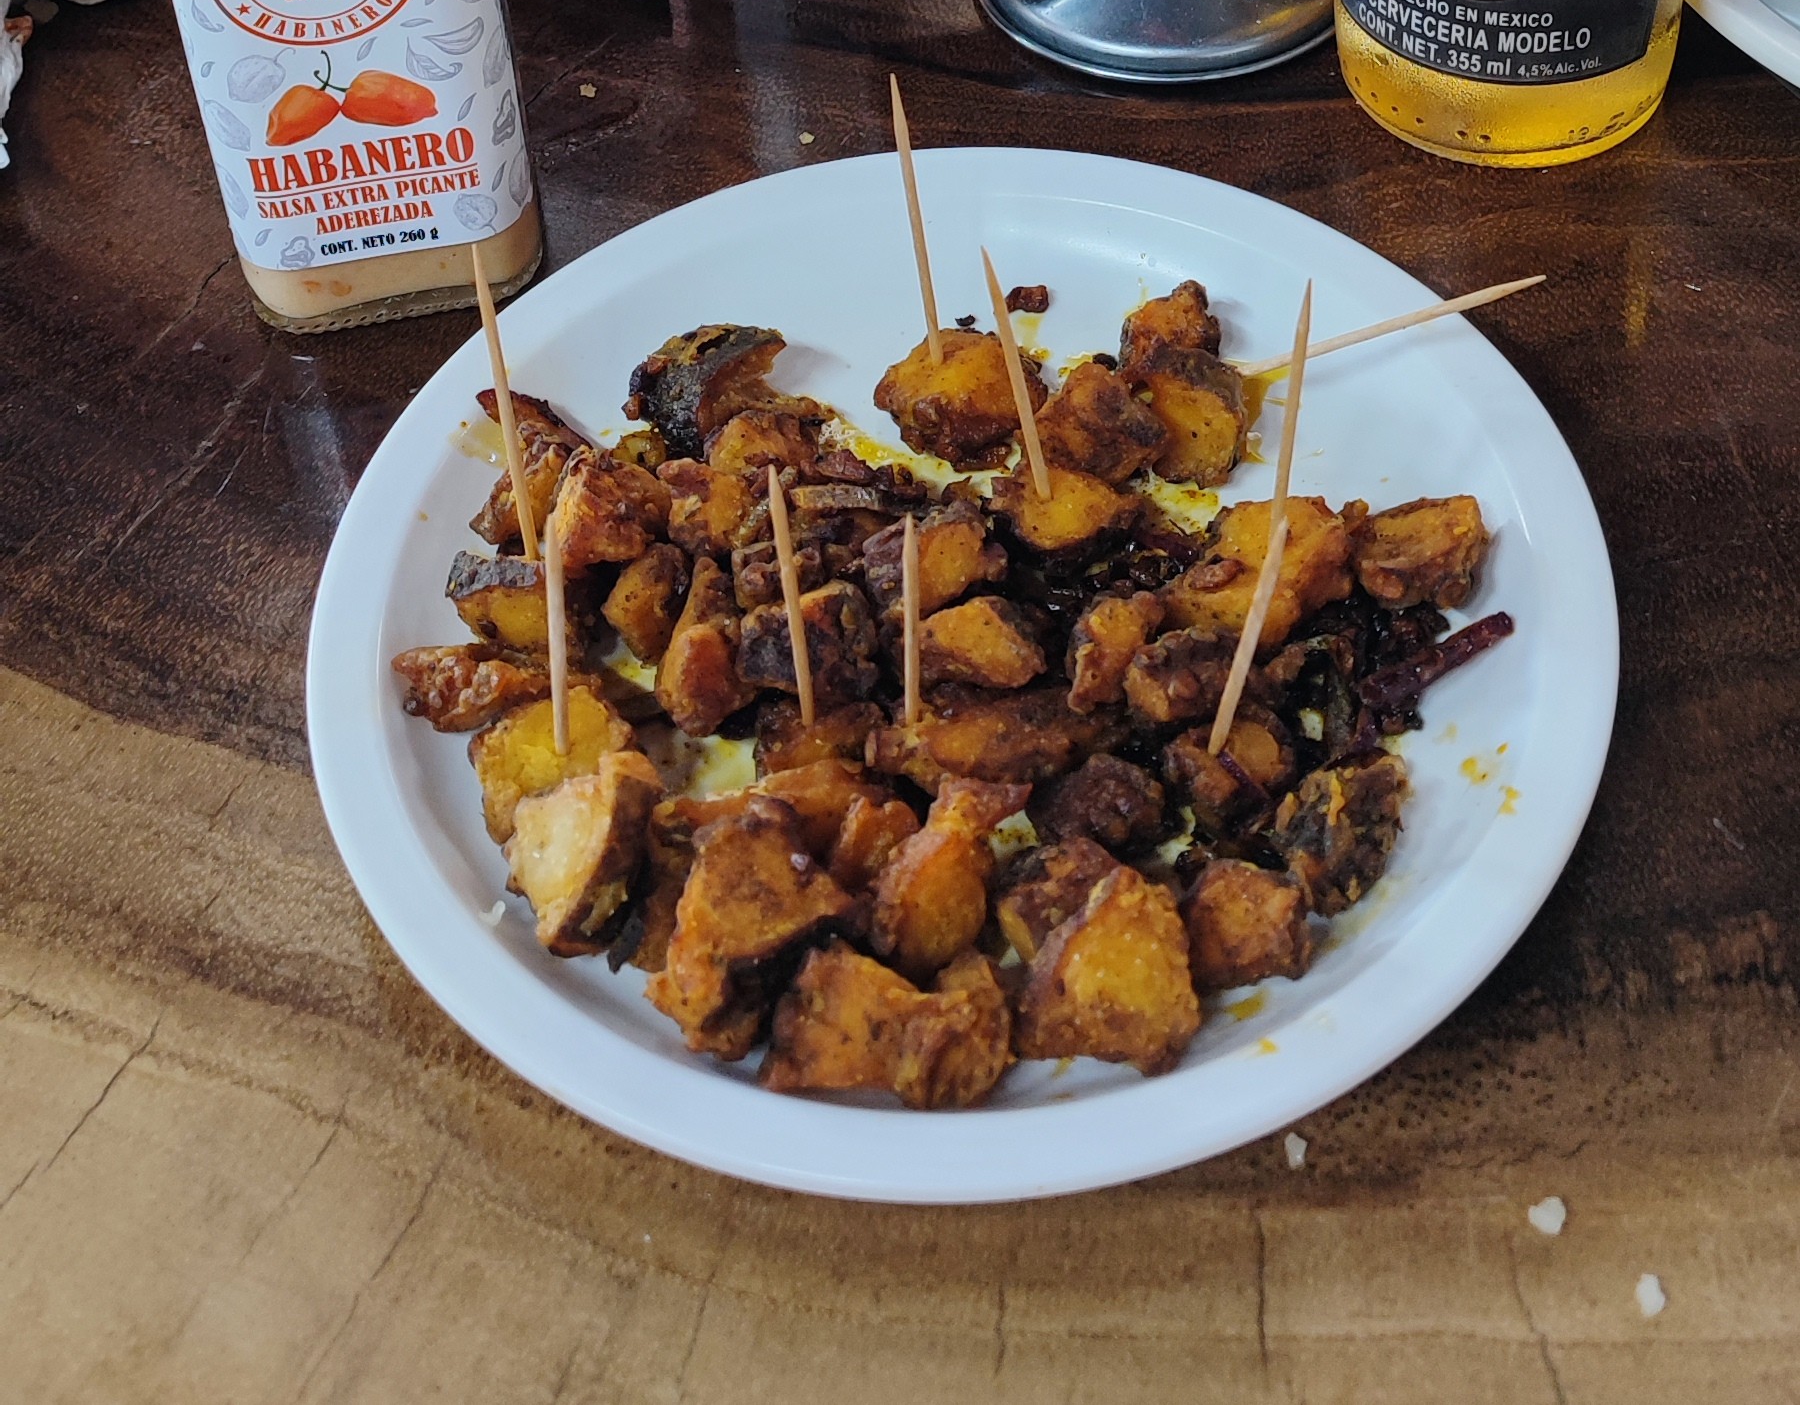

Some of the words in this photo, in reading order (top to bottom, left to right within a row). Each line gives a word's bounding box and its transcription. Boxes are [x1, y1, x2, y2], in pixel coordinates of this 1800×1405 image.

[1455, 5, 1478, 23] EN
[1484, 10, 1553, 27] MEXICO
[1358, 3, 1399, 46] CONT.
[1402, 32, 1442, 64] NET.
[1447, 49, 1482, 73] 355
[1486, 57, 1511, 76] ml
[1497, 27, 1591, 54] MODELO
[246, 127, 474, 192] HABANERO
[257, 195, 317, 220] SALSA
[323, 183, 390, 210] EXTRA
[395, 169, 481, 199] PICANTE
[316, 200, 434, 235] ADEREZADA
[320, 239, 359, 256] CONT.
[361, 233, 395, 249] NETO
[399, 228, 426, 244] 260
